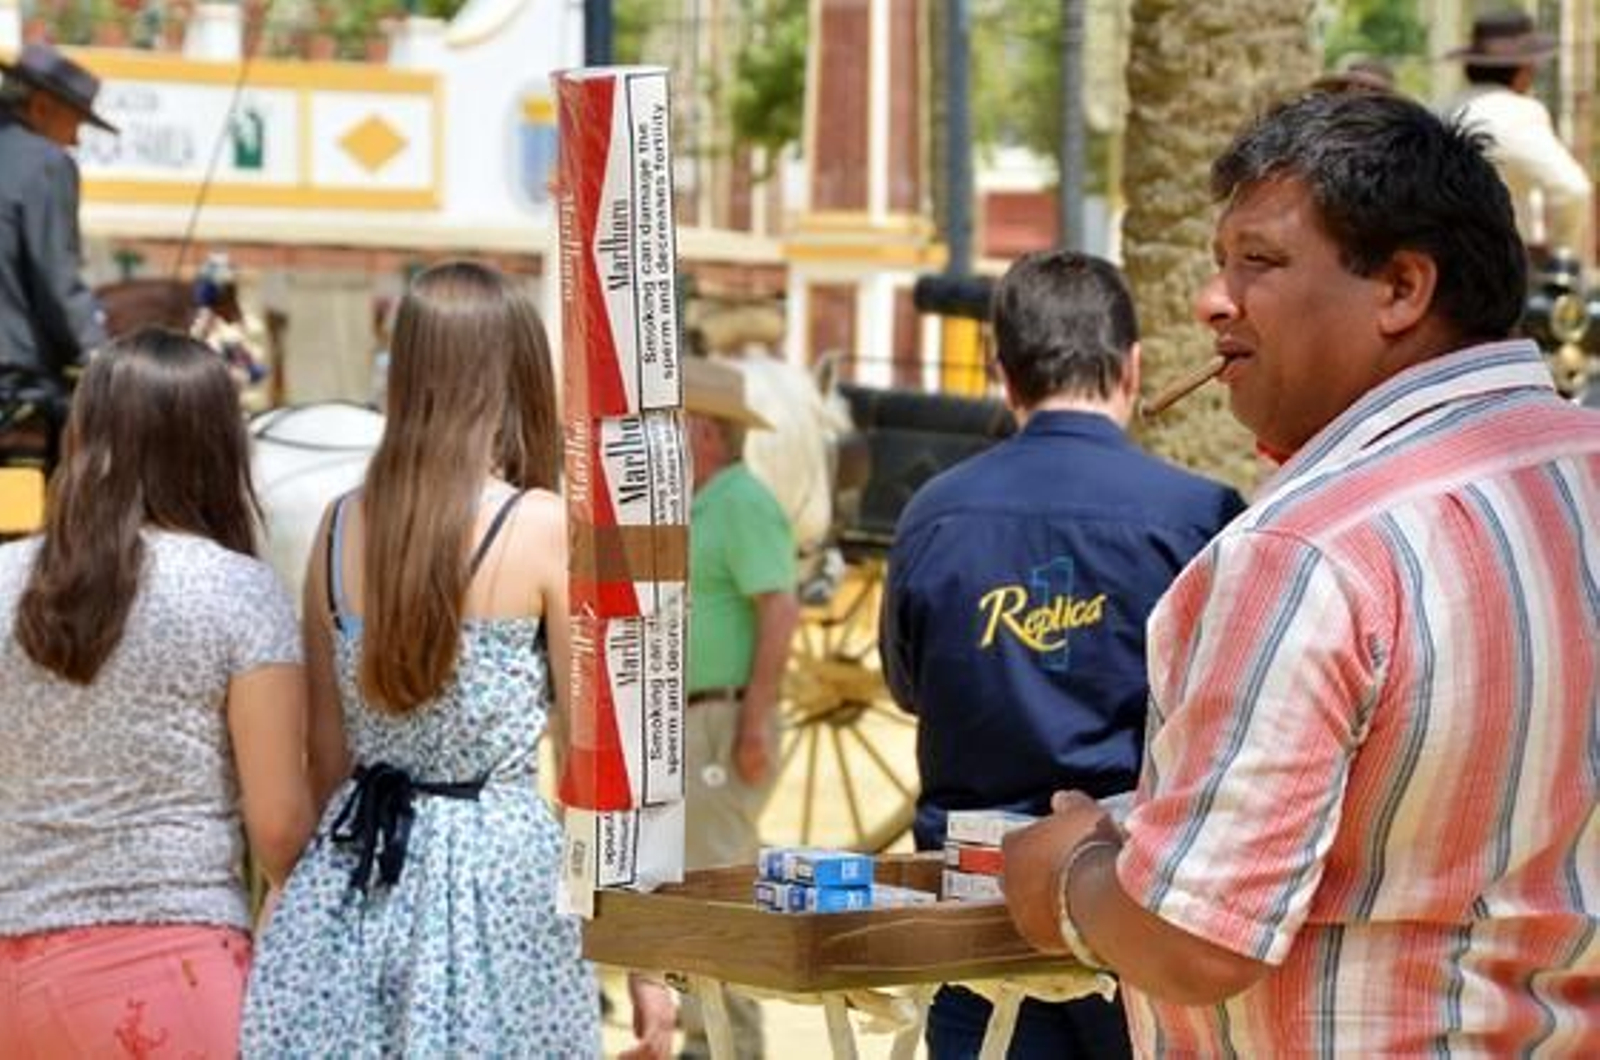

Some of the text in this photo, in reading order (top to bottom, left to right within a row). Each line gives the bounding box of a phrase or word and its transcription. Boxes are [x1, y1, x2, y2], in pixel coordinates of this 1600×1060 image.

[598, 199, 630, 291] Marlboro
[638, 122, 657, 364] Smoking can damage the
[655, 174, 669, 274] decreases
[658, 280, 671, 314] and
[661, 320, 675, 380] sperm
[564, 415, 588, 502] Marlbo
[606, 417, 648, 505] Marlbo
[609, 617, 639, 687] Marlbo
[979, 585, 1106, 651] Replica
[650, 639, 662, 672] can
[649, 679, 664, 761] Smoking
[667, 678, 679, 711] and
[667, 718, 679, 775] sperm
